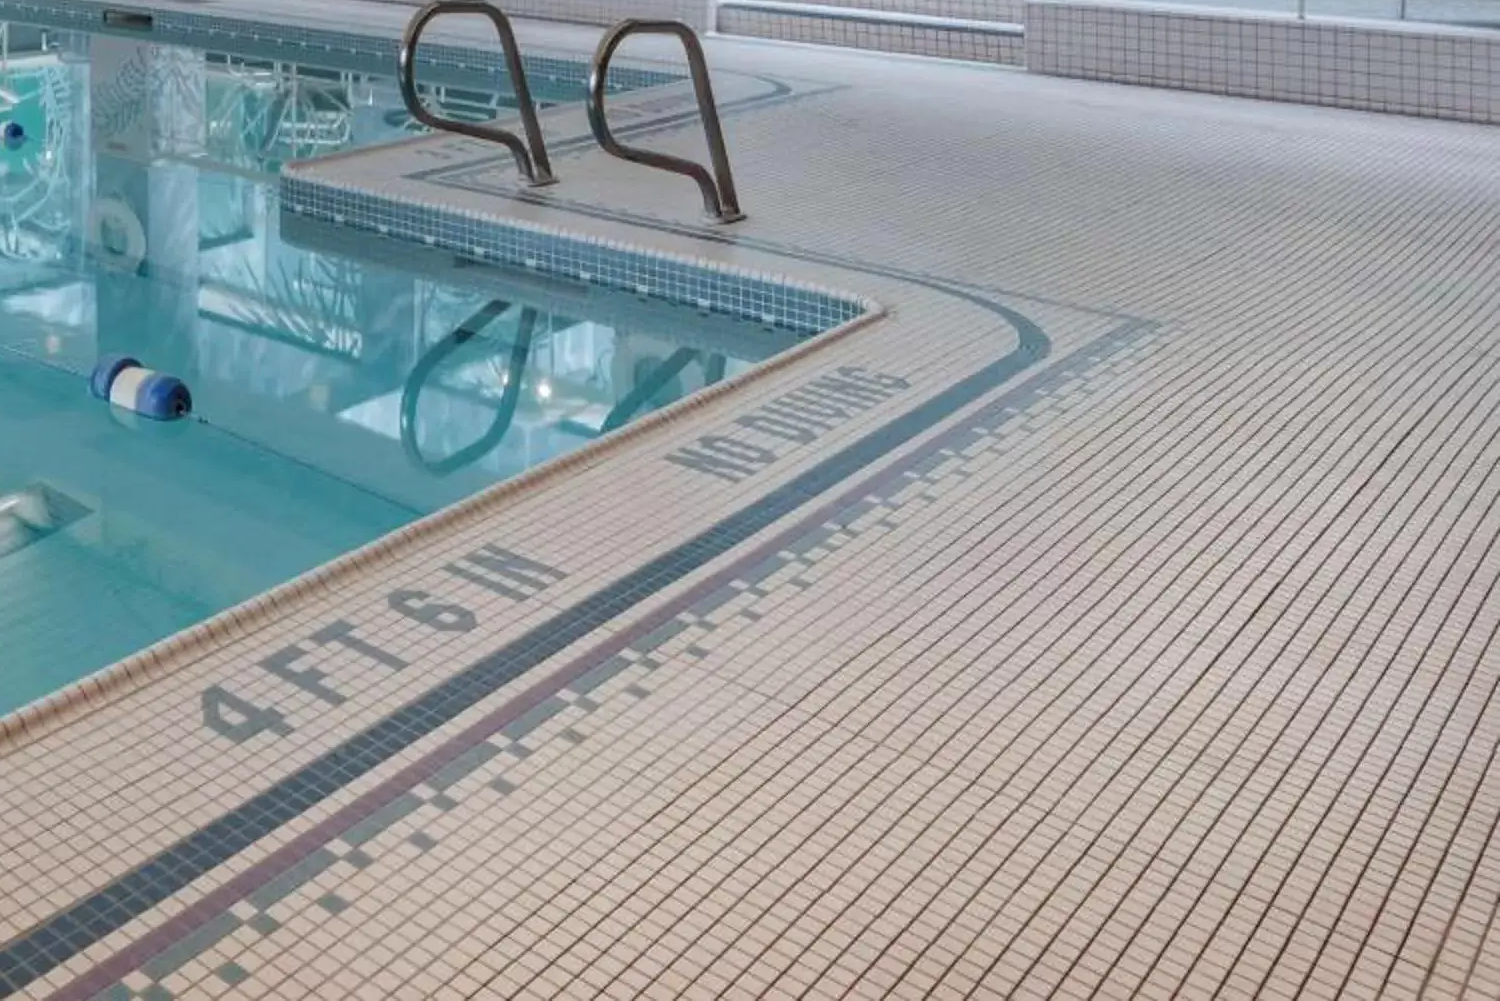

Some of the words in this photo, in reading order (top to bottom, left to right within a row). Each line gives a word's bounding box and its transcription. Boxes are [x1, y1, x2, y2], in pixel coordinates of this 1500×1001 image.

[664, 435, 779, 482] NO
[734, 365, 912, 444] DIVING
[201, 685, 294, 744] 4
[257, 619, 410, 704] FT
[388, 590, 476, 632] 6
[443, 543, 571, 603] IN
